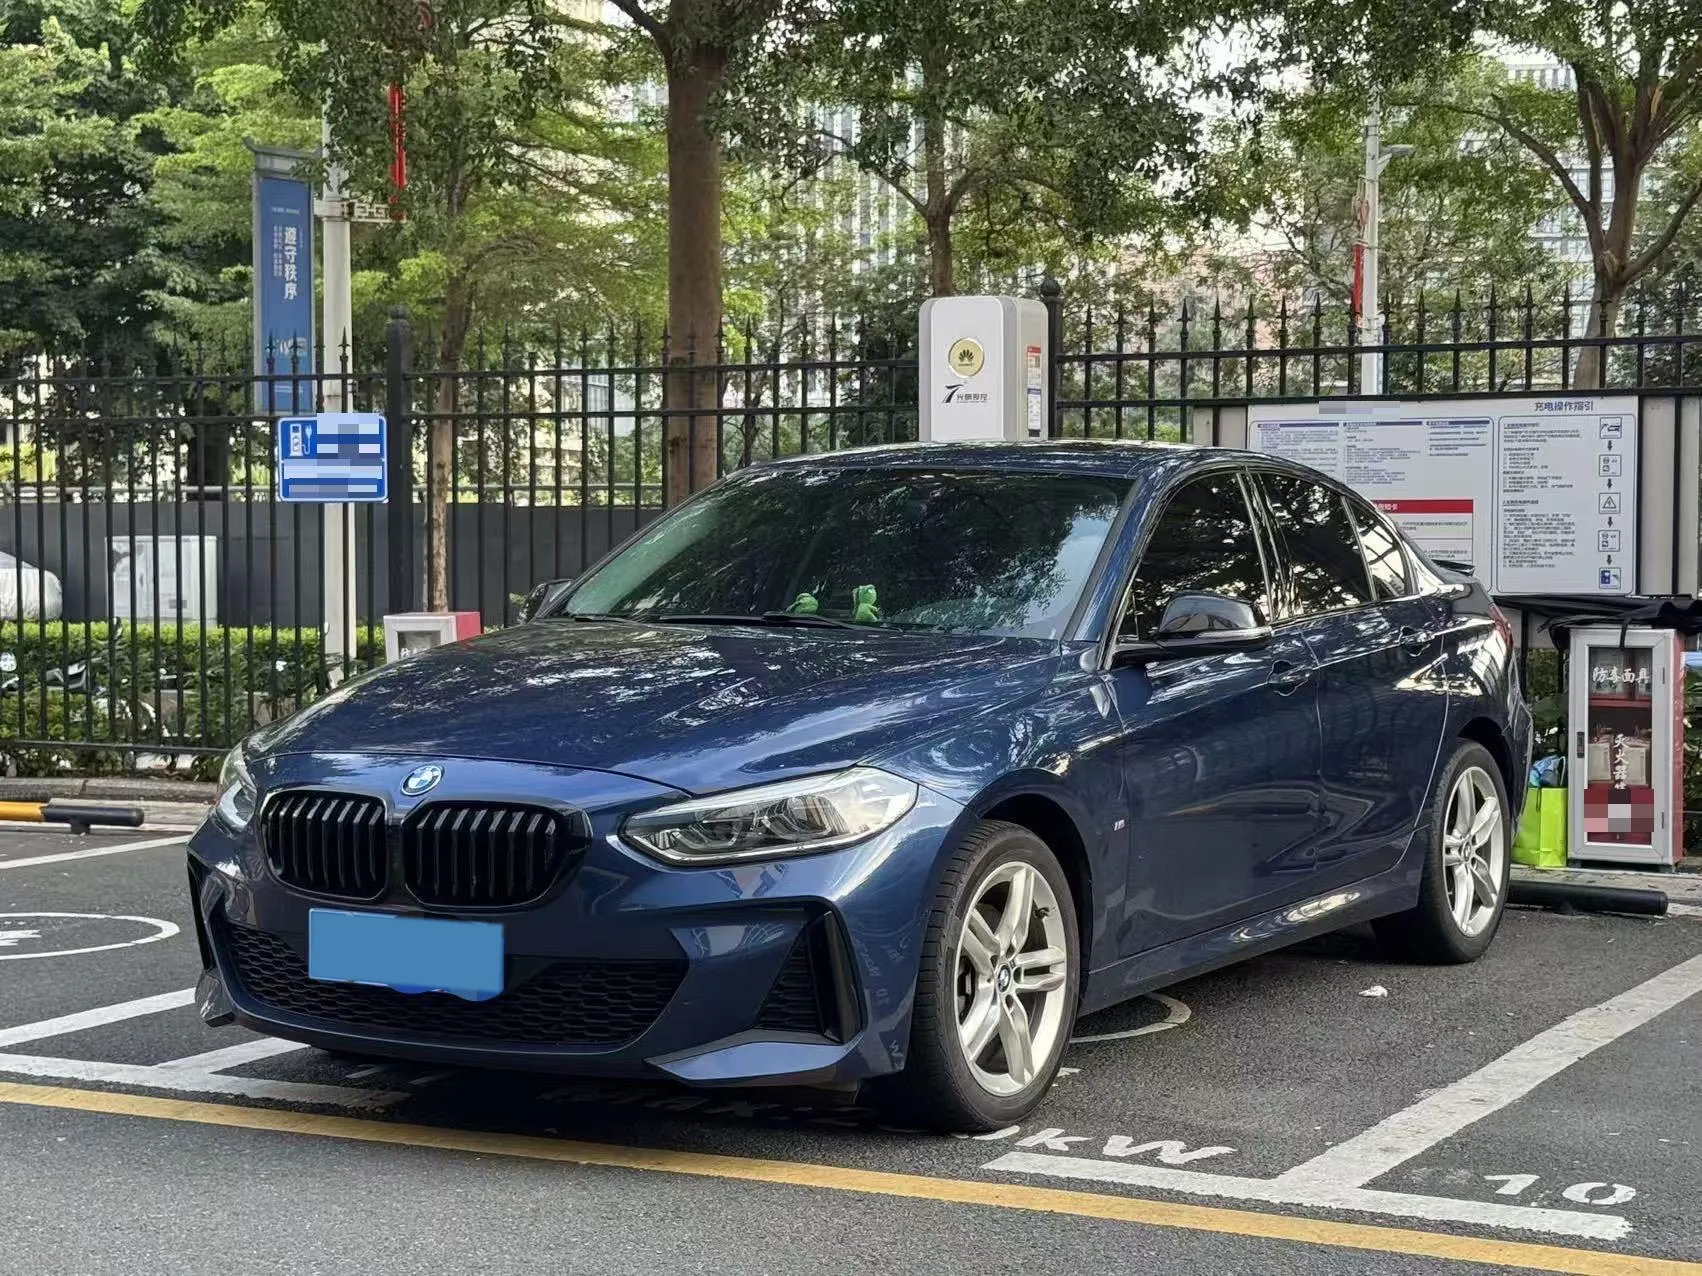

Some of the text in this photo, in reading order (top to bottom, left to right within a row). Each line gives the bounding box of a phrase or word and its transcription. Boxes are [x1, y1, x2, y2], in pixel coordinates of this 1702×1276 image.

[284, 226, 298, 300] 遵守秩序
[1534, 401, 1594, 412] 充电操作指引
[1592, 666, 1650, 684] 防毒面具
[1484, 1173, 1637, 1206] 10
